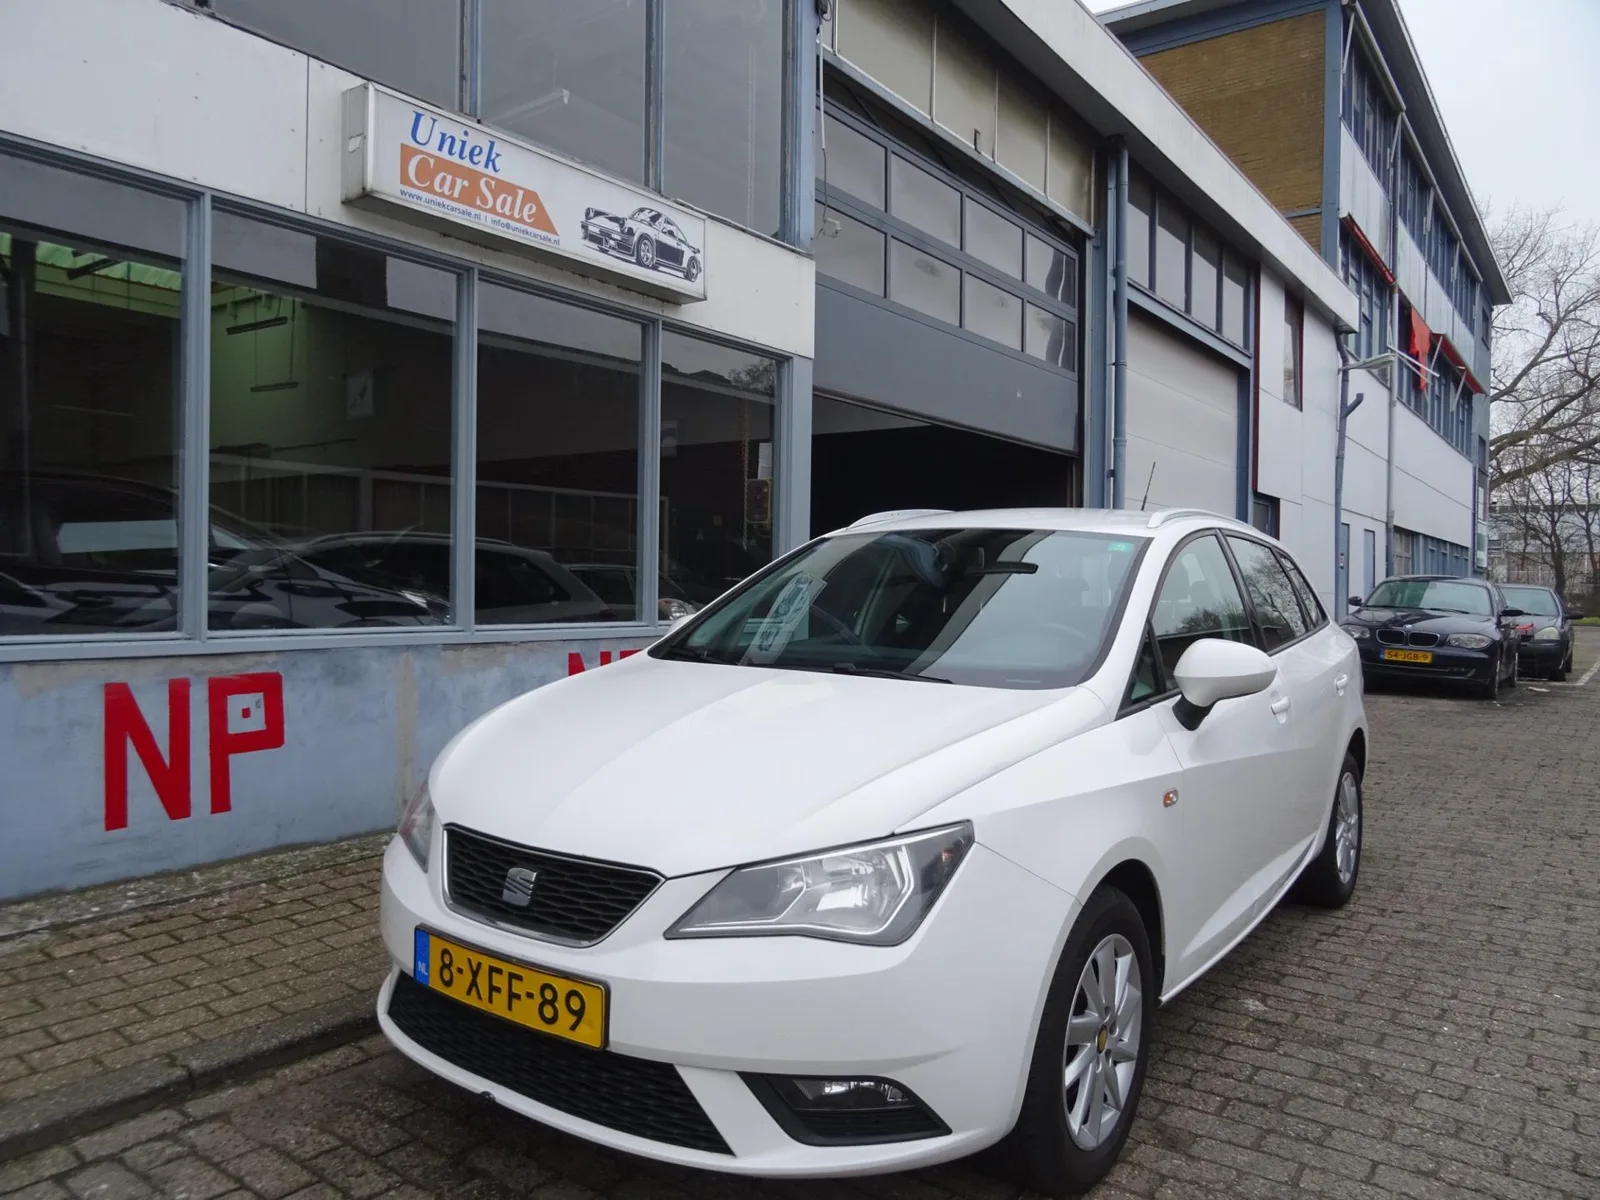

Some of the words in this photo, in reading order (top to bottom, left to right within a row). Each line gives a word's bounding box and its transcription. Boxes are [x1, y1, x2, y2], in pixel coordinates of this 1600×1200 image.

[411, 111, 502, 172] Uniek
[400, 188, 481, 221] www.uniekcarsale.nl
[491, 218, 560, 246] info@uniekcarsale.nl
[408, 154, 469, 199] Car
[476, 177, 537, 223] Sale
[104, 671, 285, 831] NP
[418, 961, 428, 976] NL
[439, 947, 587, 1032] 8-XFF-89
